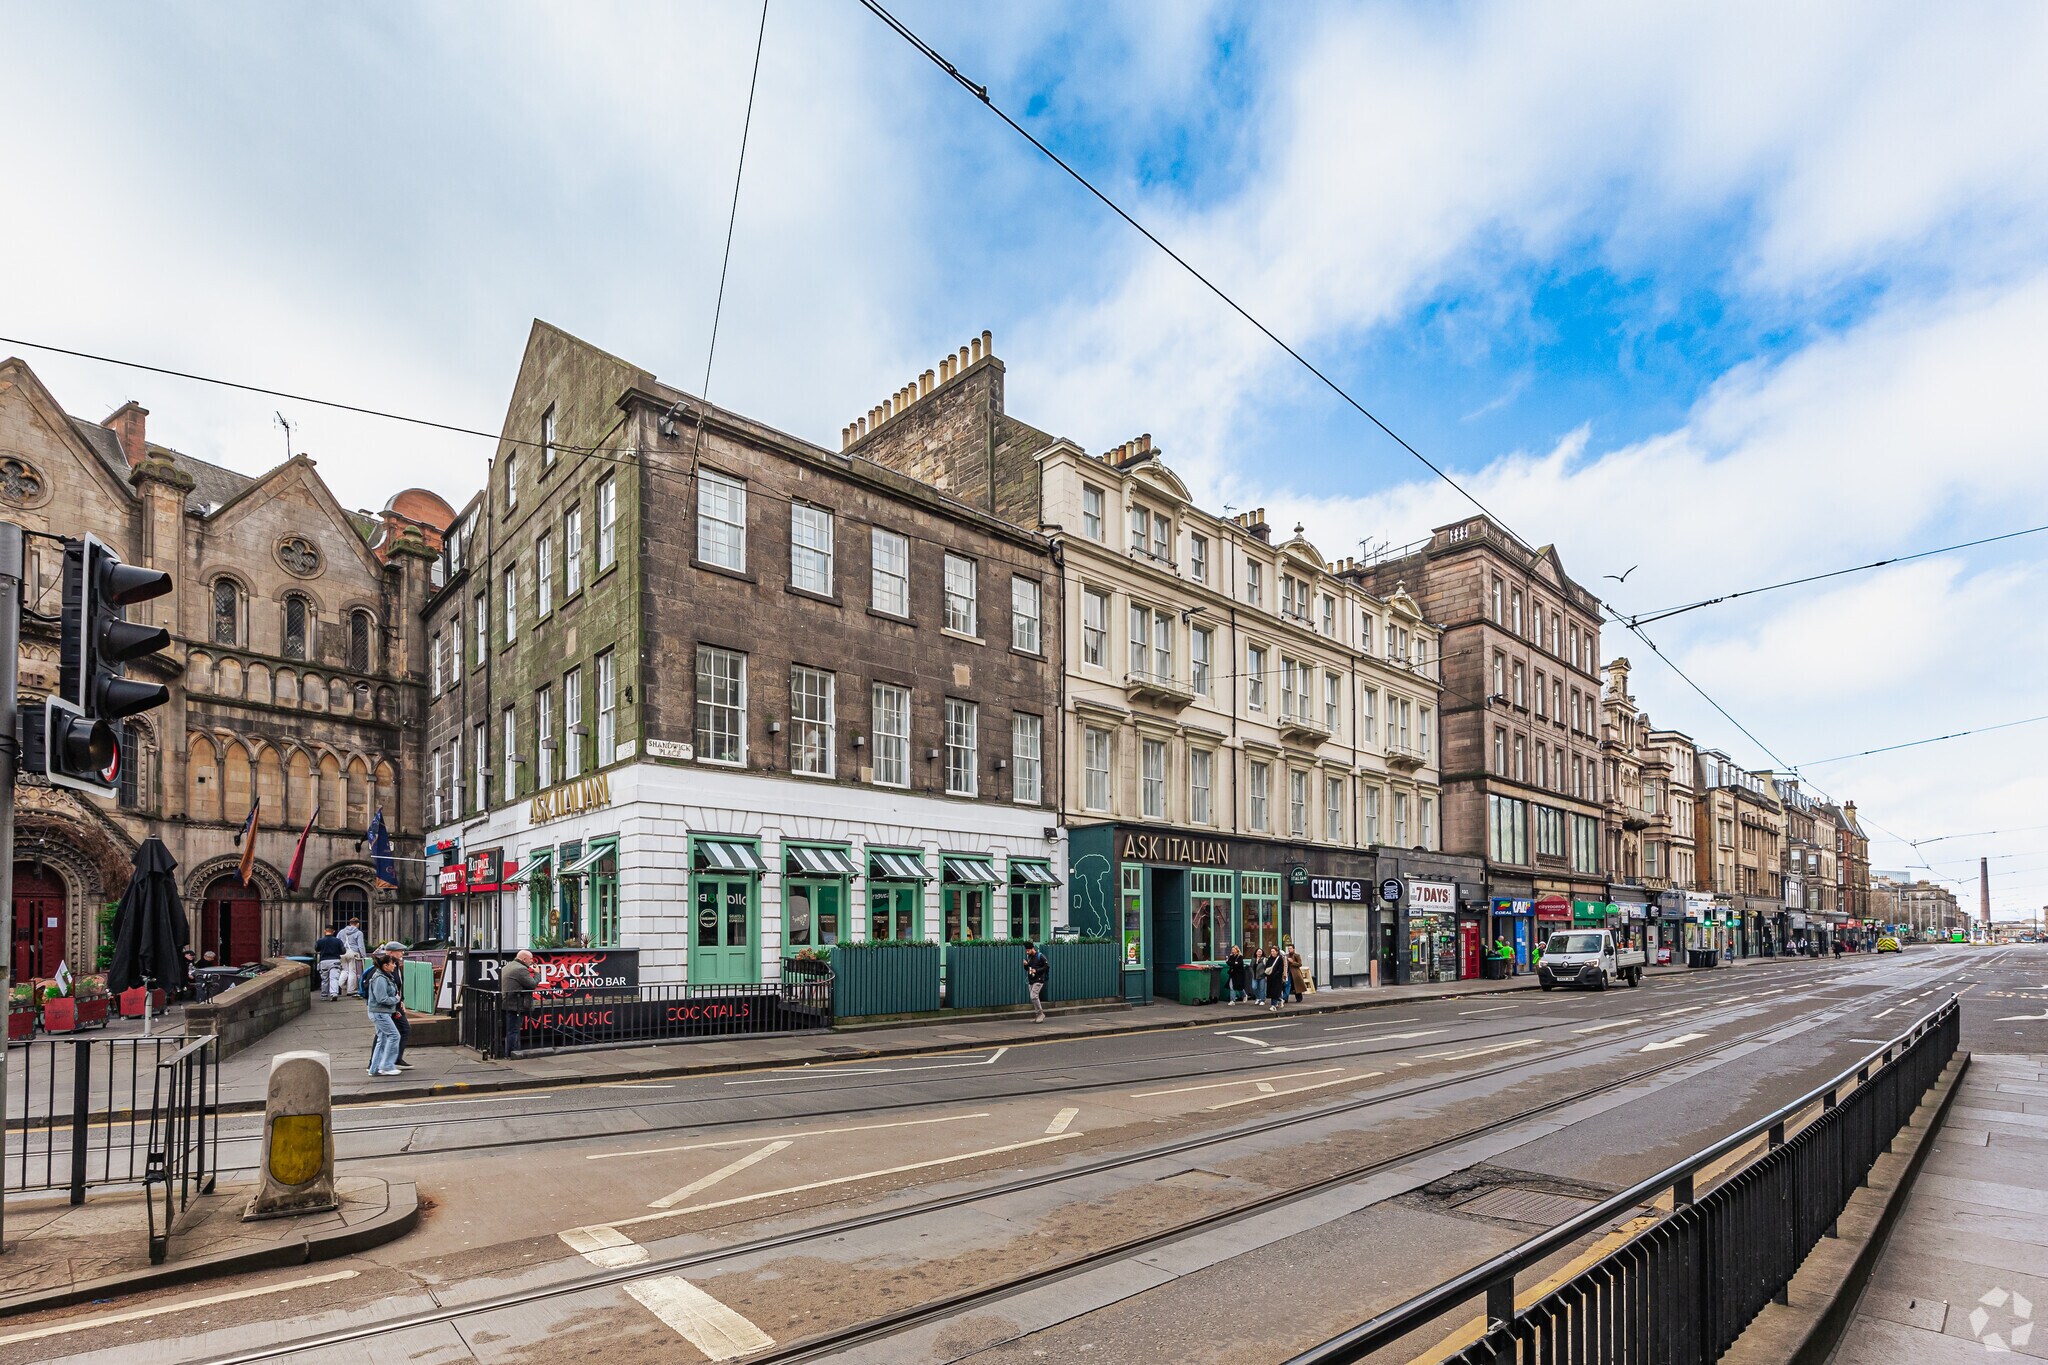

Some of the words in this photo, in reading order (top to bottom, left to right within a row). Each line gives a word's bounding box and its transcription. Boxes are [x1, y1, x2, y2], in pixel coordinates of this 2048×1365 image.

[648, 740, 691, 751] SHANDWICK
[659, 749, 681, 757] PLACE
[529, 791, 553, 824] ASK
[554, 772, 609, 817] ITALIAN
[1123, 834, 1159, 860] ASK
[1165, 838, 1229, 864] ITALIAN
[1312, 879, 1351, 900] CHILO'S
[1416, 887, 1422, 901] 7
[1424, 888, 1448, 903] DAYS
[539, 962, 600, 984] PACK
[569, 977, 604, 988] PIANO
[605, 976, 627, 986] BAR
[558, 1010, 614, 1028] MUSIC
